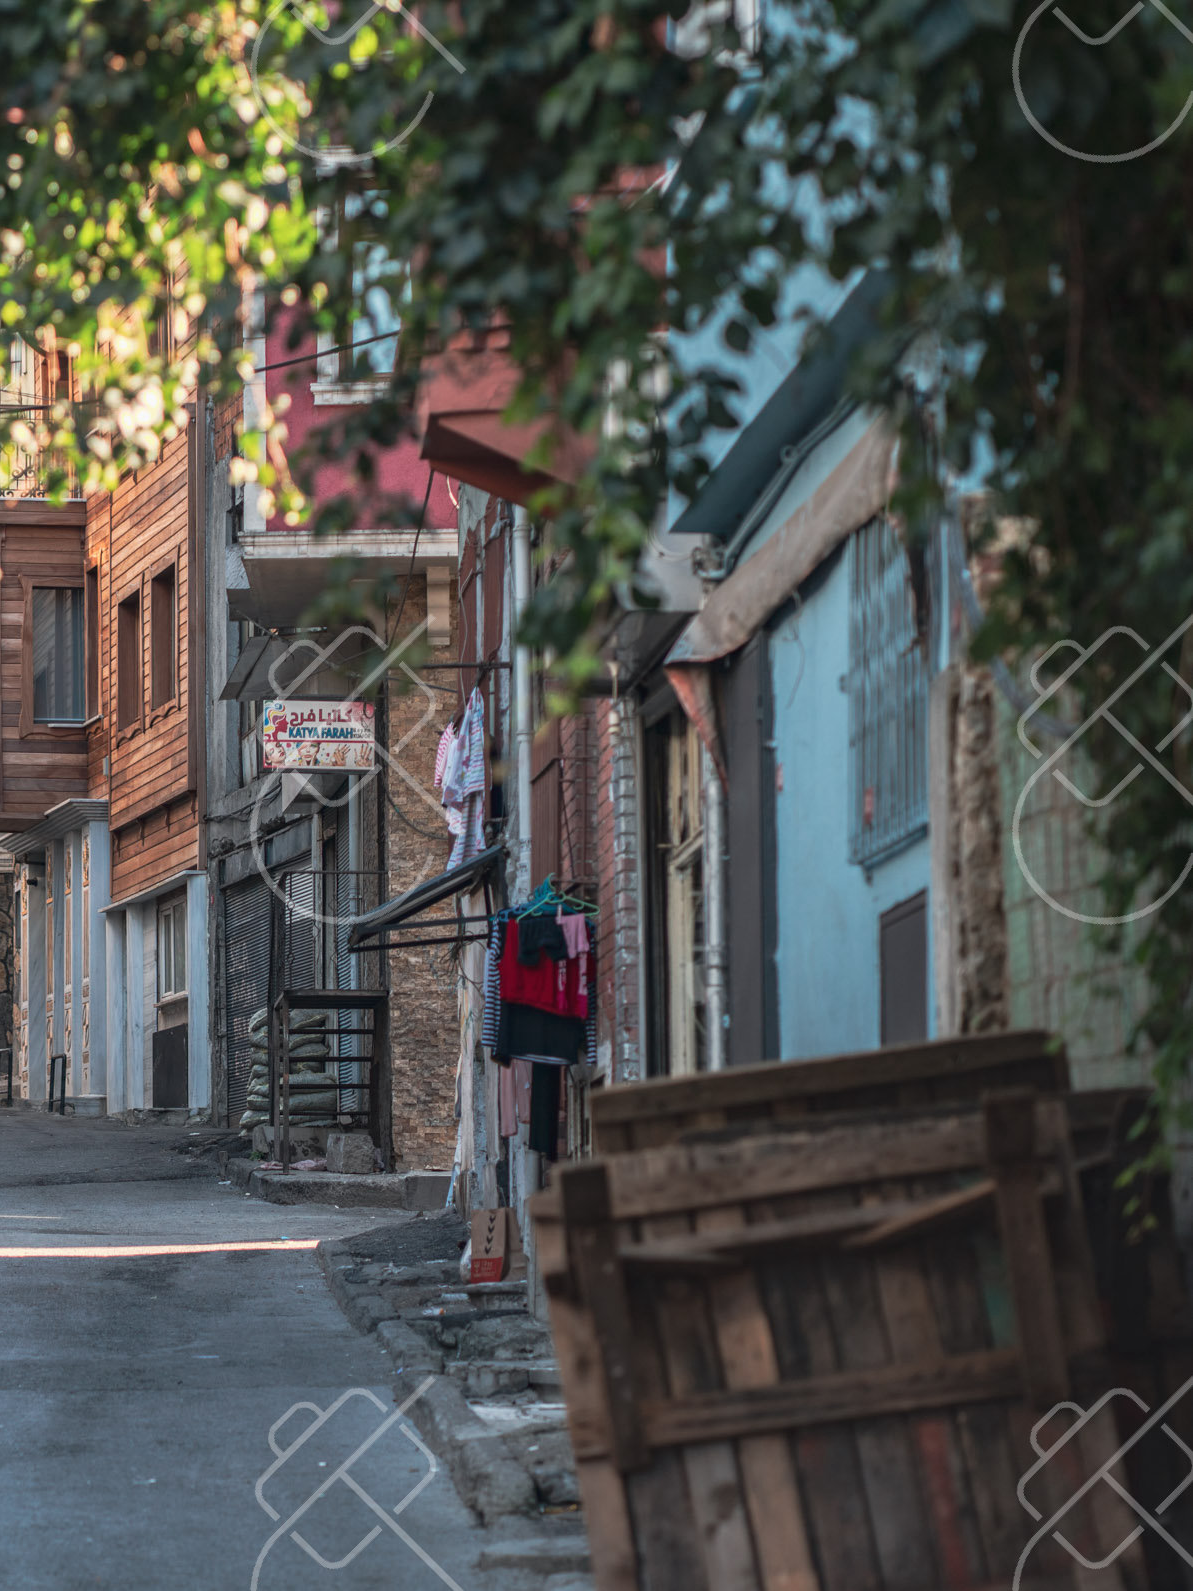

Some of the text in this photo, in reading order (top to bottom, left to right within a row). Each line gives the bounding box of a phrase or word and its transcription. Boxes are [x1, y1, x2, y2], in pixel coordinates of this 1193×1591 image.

[289, 709, 352, 726] كاتيا فرح
[289, 727, 353, 739] KATYA FARAH
